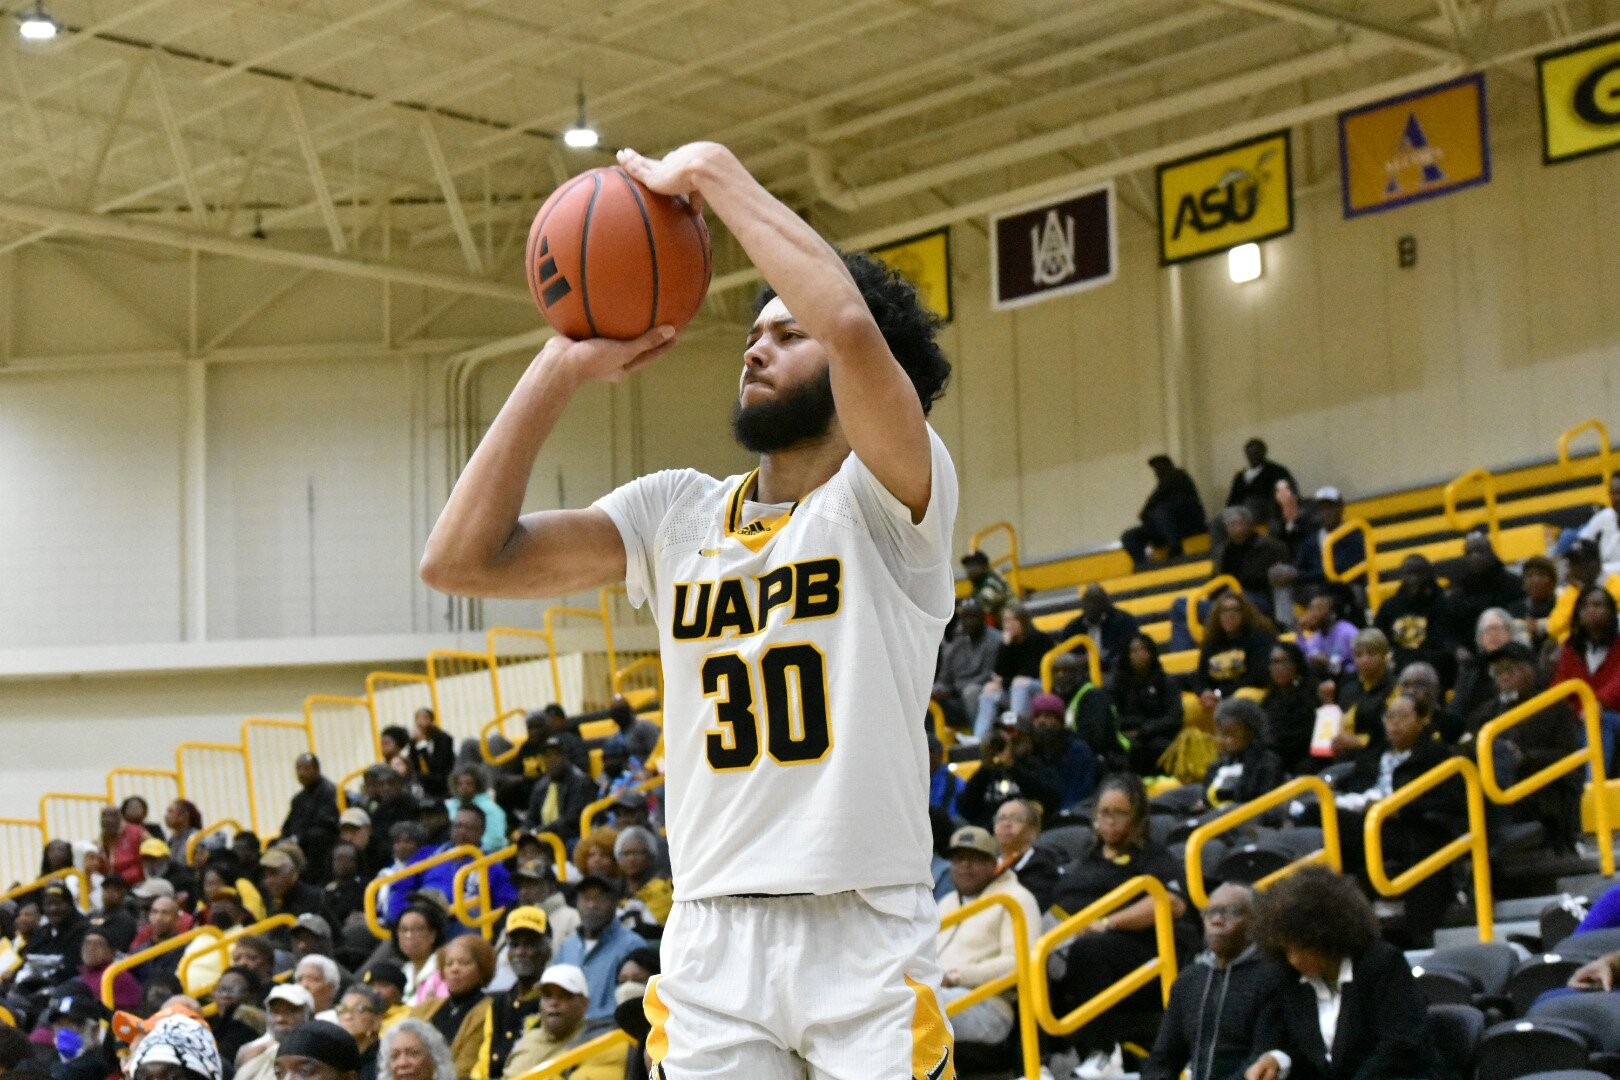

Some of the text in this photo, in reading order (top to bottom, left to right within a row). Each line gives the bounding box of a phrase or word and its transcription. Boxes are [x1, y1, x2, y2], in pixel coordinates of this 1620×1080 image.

[1171, 181, 1258, 241] ASU
[672, 556, 844, 642] UAPB
[699, 641, 835, 773] 30
